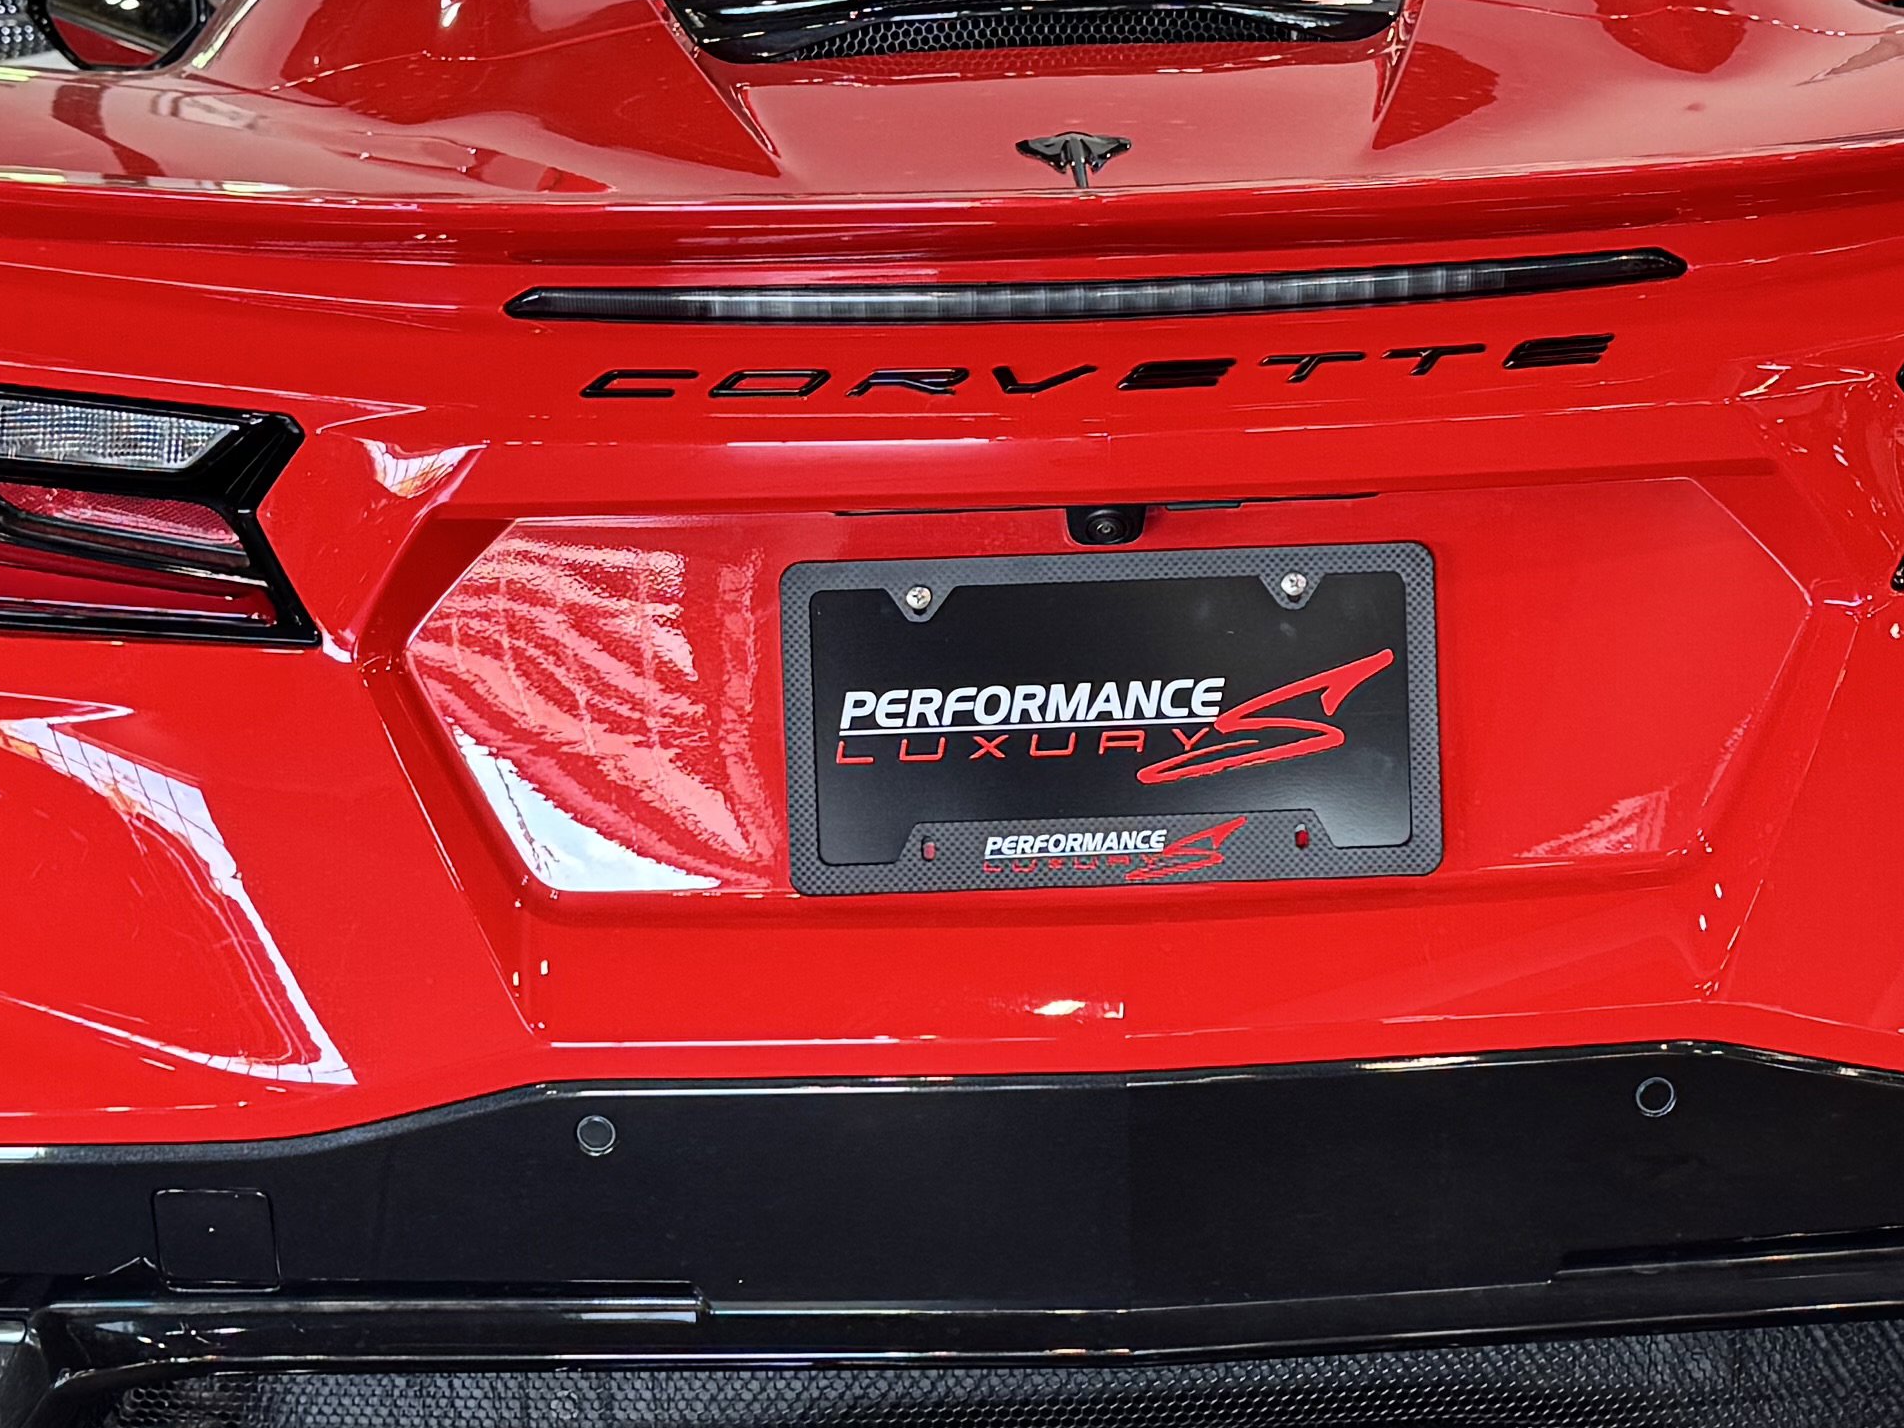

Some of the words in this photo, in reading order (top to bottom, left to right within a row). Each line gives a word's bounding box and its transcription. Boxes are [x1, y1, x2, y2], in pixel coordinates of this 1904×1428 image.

[579, 332, 1615, 400] CORVETTE
[839, 676, 1225, 730] PERFORMANCE
[836, 727, 1209, 765] LUXURY
[984, 829, 1167, 856] PERFORMANCE
